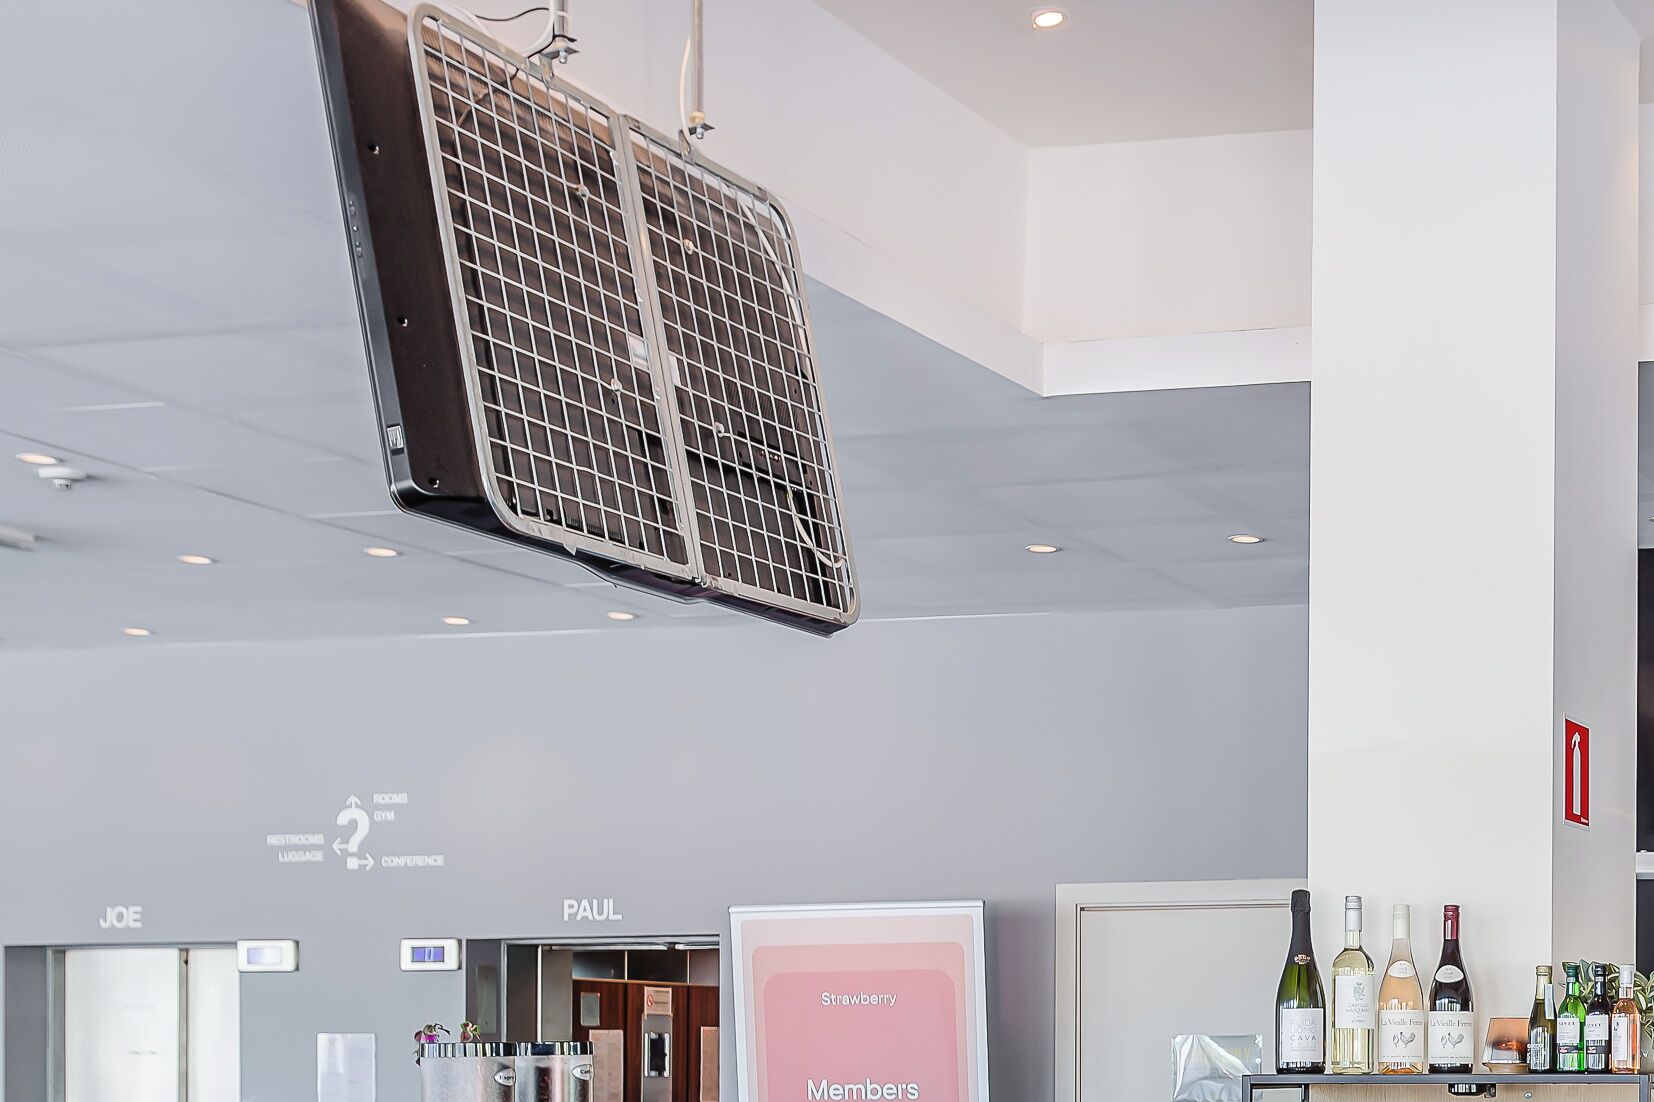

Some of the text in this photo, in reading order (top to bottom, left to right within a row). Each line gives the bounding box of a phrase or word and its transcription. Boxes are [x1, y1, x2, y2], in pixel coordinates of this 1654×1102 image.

[373, 793, 408, 804] ROOMS
[373, 810, 395, 821] GYM
[266, 834, 324, 846] RESTROOMS
[278, 851, 324, 862] LUGGAGE
[381, 855, 445, 867] CONFERENCE
[563, 898, 623, 921] PAUL
[99, 906, 143, 929] JOE
[820, 991, 897, 1006] Strawberry
[806, 1078, 920, 1101] Members
